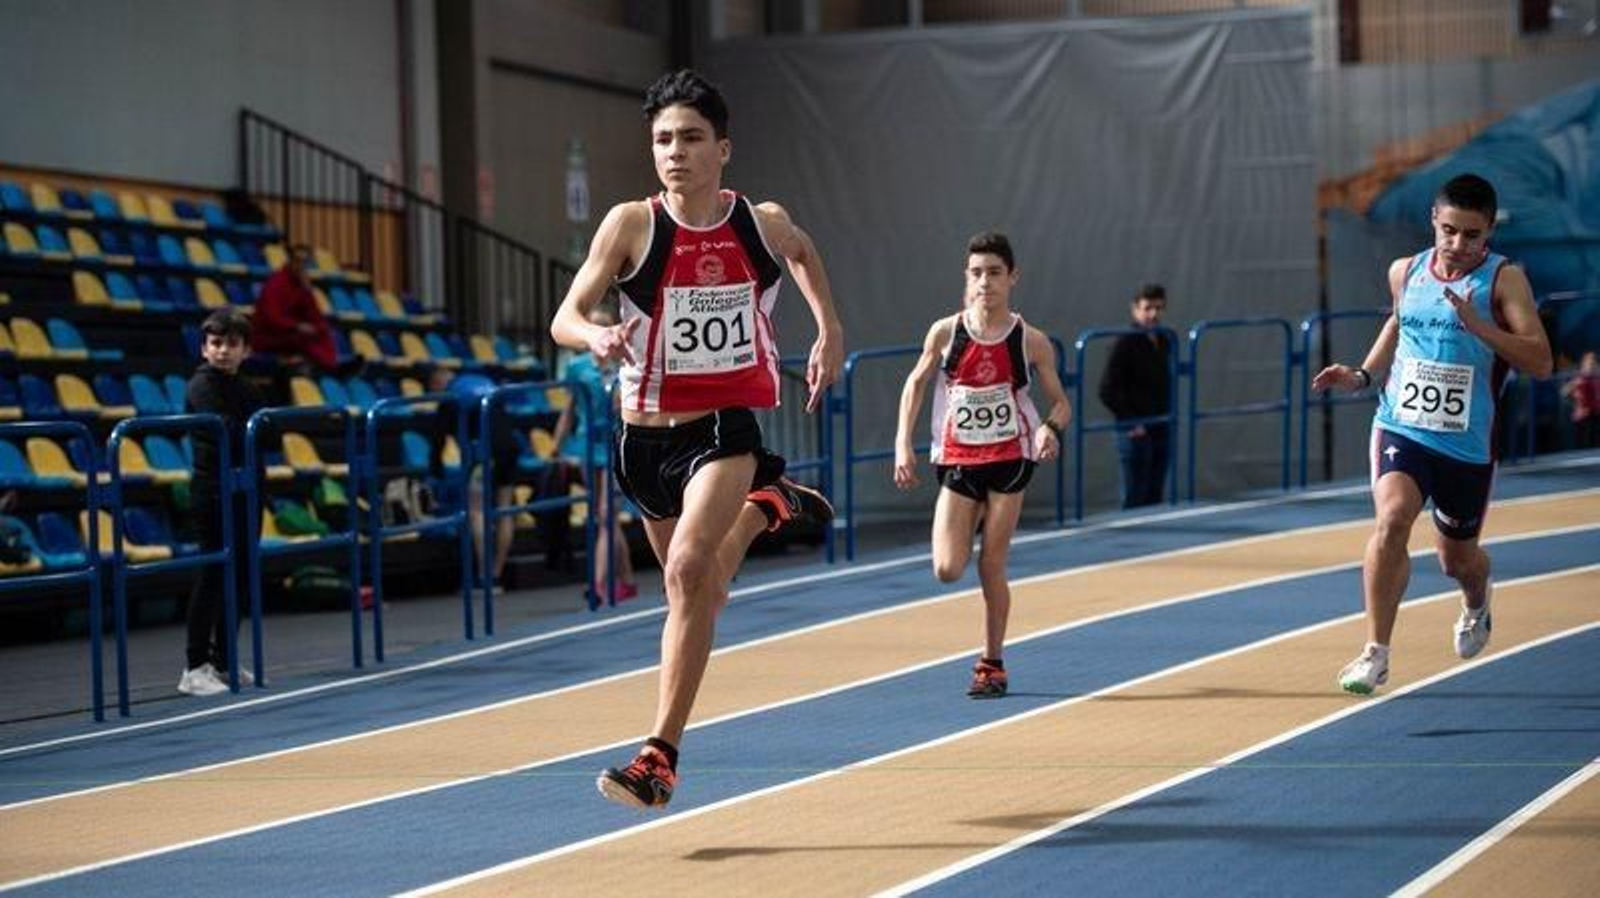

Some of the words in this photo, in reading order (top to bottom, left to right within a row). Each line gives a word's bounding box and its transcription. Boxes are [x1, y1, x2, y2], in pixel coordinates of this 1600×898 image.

[672, 312, 752, 353] 301
[1402, 382, 1465, 416] 295
[957, 403, 1012, 430] 299
